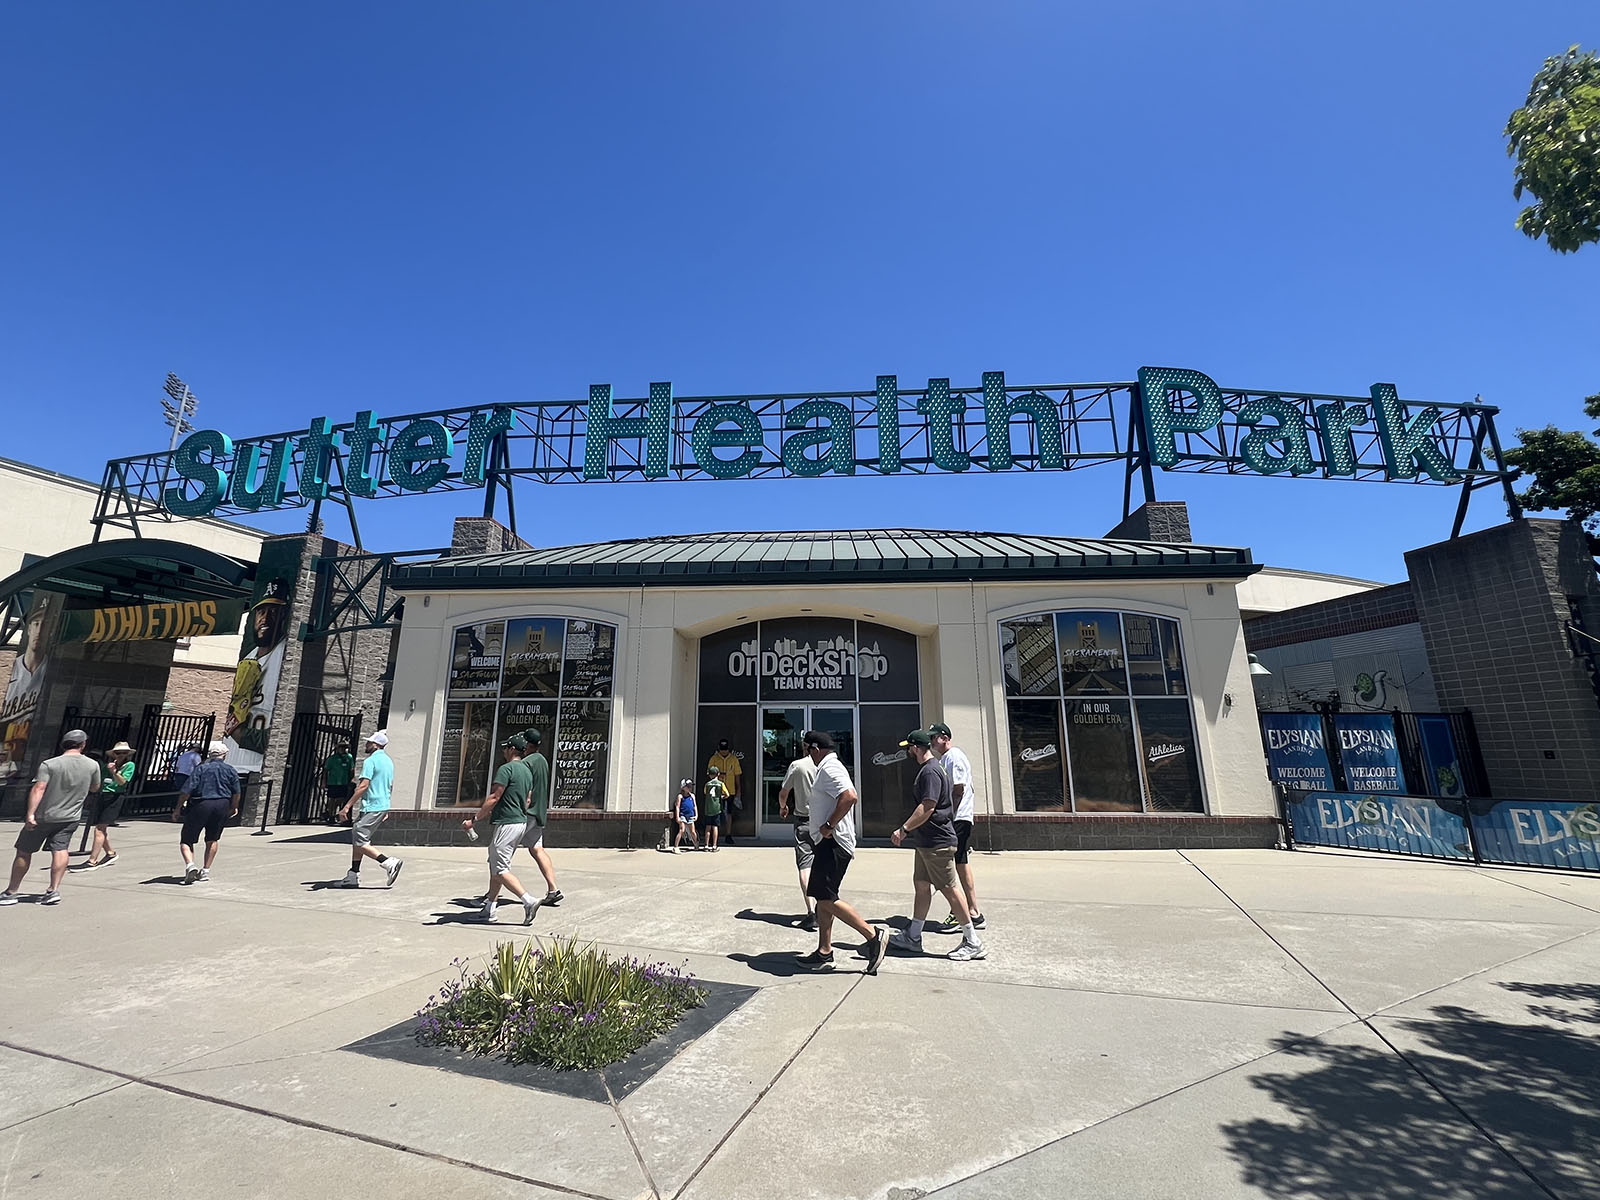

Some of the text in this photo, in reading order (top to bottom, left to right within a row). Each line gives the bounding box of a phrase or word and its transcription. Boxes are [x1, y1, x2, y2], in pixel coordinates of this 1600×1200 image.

[162, 366, 1462, 517] Sutter Health Park
[83, 600, 217, 643] ATHLETICS
[510, 652, 559, 661] SACRAMENTO
[1064, 648, 1118, 657] SACRAMENTO
[471, 656, 500, 667] WELCOME
[773, 677, 842, 689] TEAM STORE
[516, 704, 541, 713] IN OUR
[1083, 703, 1110, 713] IN OUR
[506, 715, 549, 724] GOLDEN ERA
[1074, 714, 1122, 724] GOLDEN ERA
[1267, 729, 1324, 750] ELYSIAN
[1339, 729, 1395, 750] ELYSIAN
[1148, 743, 1185, 759] Athletics
[1277, 767, 1326, 778] WELCOME
[1350, 766, 1397, 778] WELCOME
[1353, 780, 1399, 791] BASEBALL
[709, 786, 716, 797] 4
[1316, 799, 1432, 839] ELYSIAN
[1509, 808, 1600, 846] ELYS
